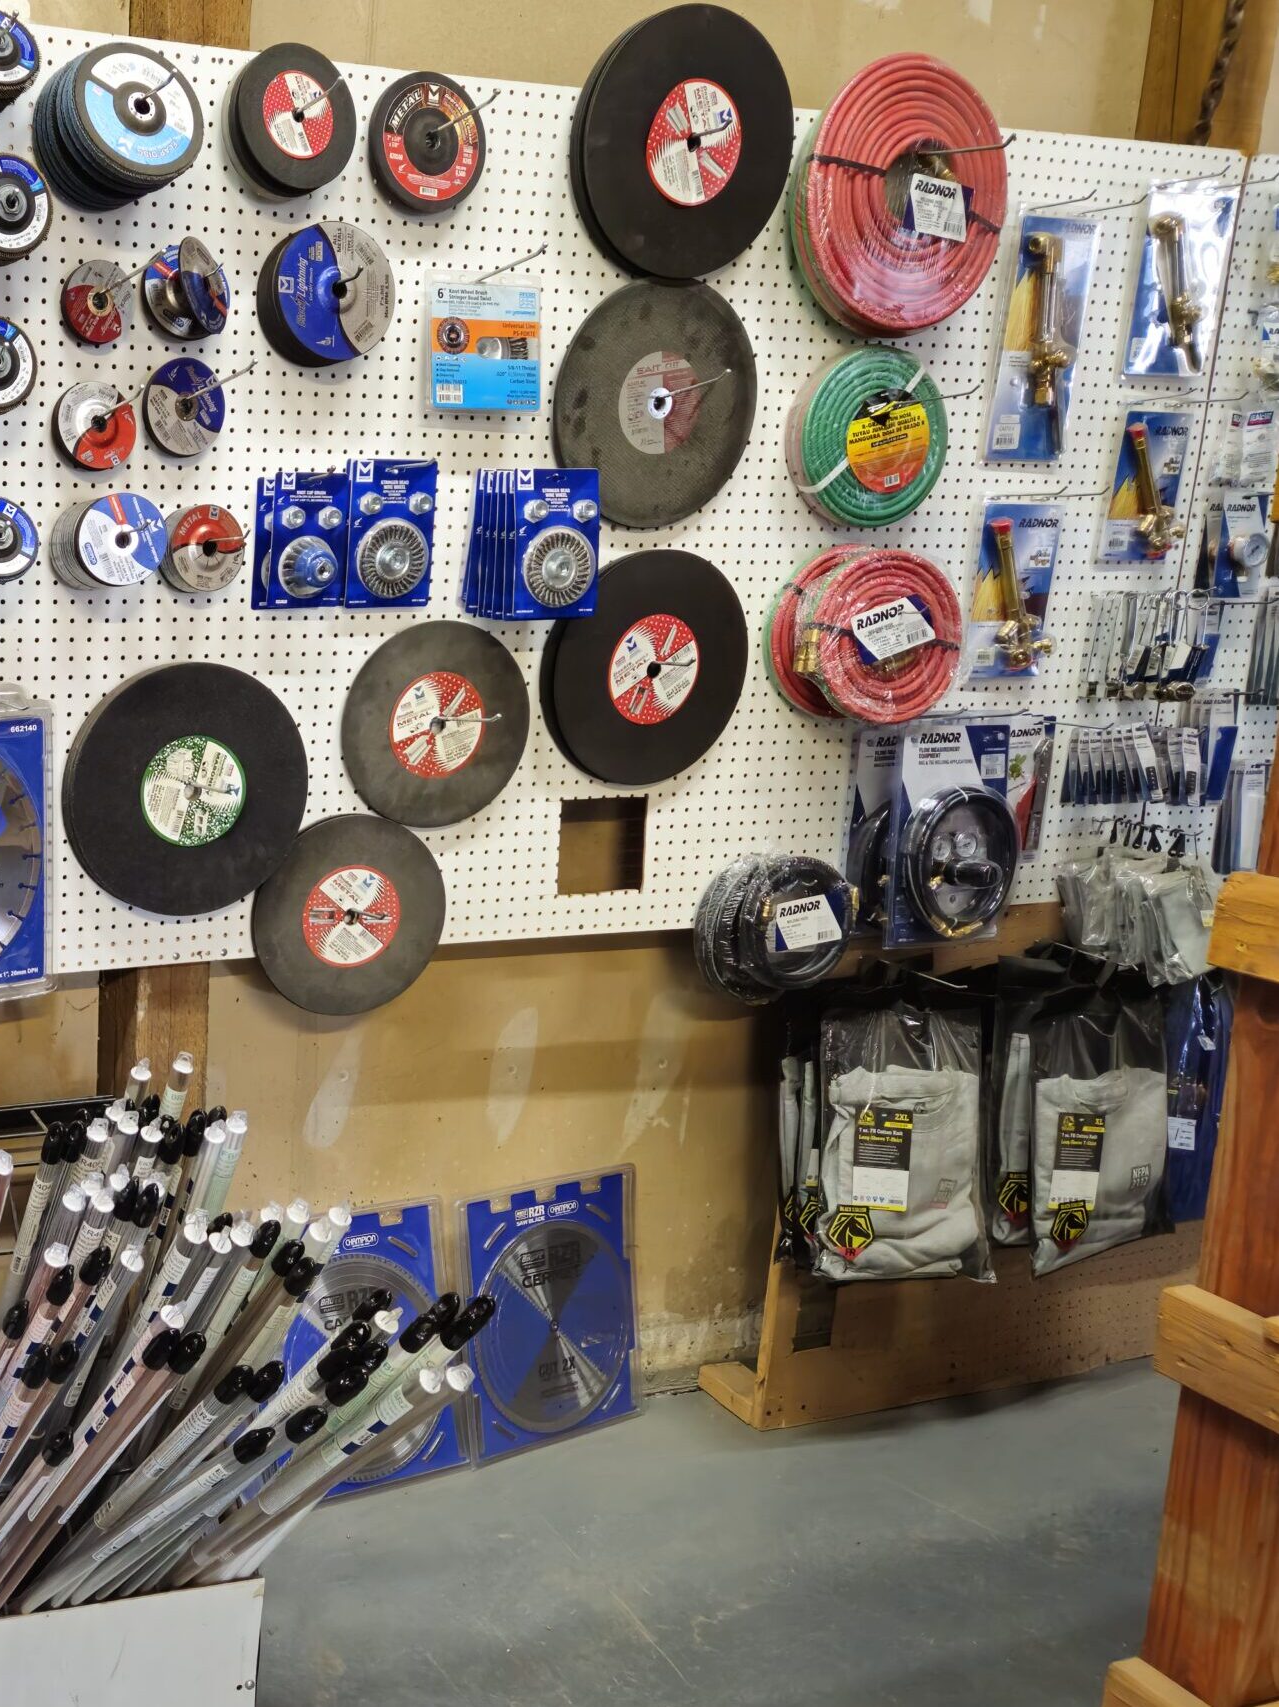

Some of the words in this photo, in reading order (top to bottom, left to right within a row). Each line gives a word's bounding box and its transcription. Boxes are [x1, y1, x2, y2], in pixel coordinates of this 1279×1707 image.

[390, 87, 423, 130] METAL
[915, 179, 957, 200] RADNOR
[297, 257, 309, 298] Lightning
[1156, 426, 1189, 437] RADNOR
[849, 434, 880, 445] MANGUERA
[1226, 503, 1256, 512] RADNOR
[179, 510, 203, 536] METAL
[1018, 517, 1059, 528] RADNOR
[397, 711, 432, 727] METAL
[10, 724, 38, 734] 662140
[919, 733, 962, 744] RADNOR
[333, 879, 359, 904] METAL
[779, 900, 820, 918] RADNOR
[27, 967, 39, 975] DPH
[894, 1113, 909, 1121] 2XL
[1132, 1165, 1149, 1178] NFPA
[528, 1205, 545, 1218] RZR
[549, 1202, 577, 1215] CHAMPION
[529, 1216, 545, 1225] BLADE
[344, 1234, 377, 1248] CHAMPION
[561, 1355, 576, 1372] 2X
